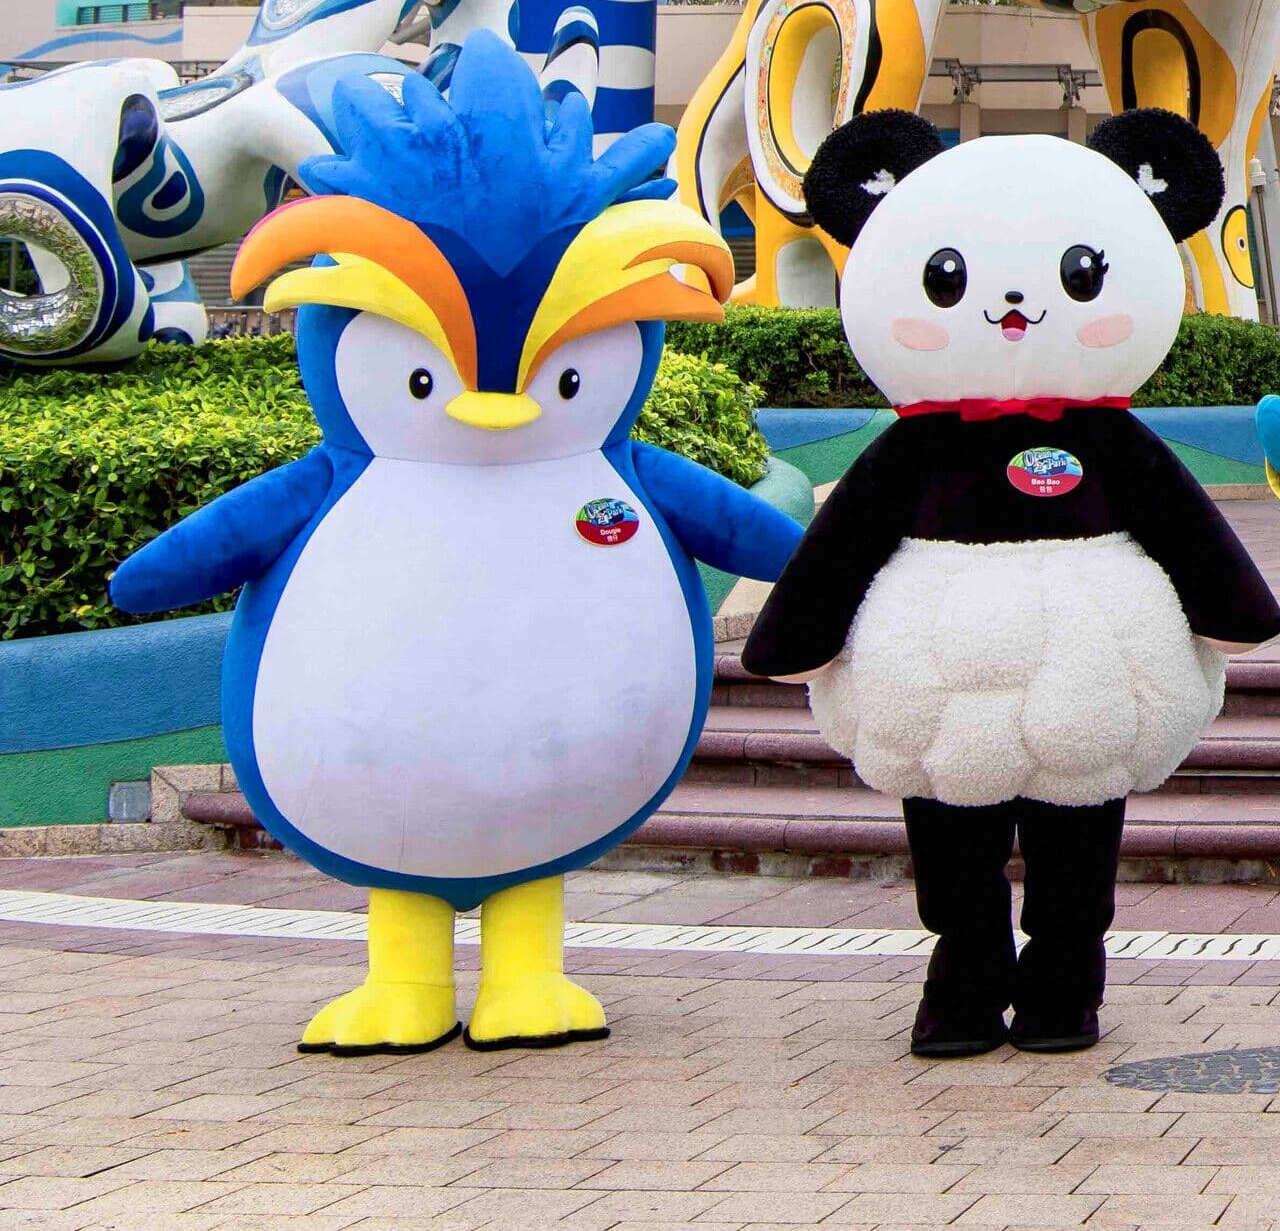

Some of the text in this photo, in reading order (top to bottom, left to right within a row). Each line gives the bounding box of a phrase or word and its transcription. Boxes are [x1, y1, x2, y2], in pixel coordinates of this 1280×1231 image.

[1031, 478, 1061, 486] Bao Bao
[600, 527, 621, 536] Dougie
